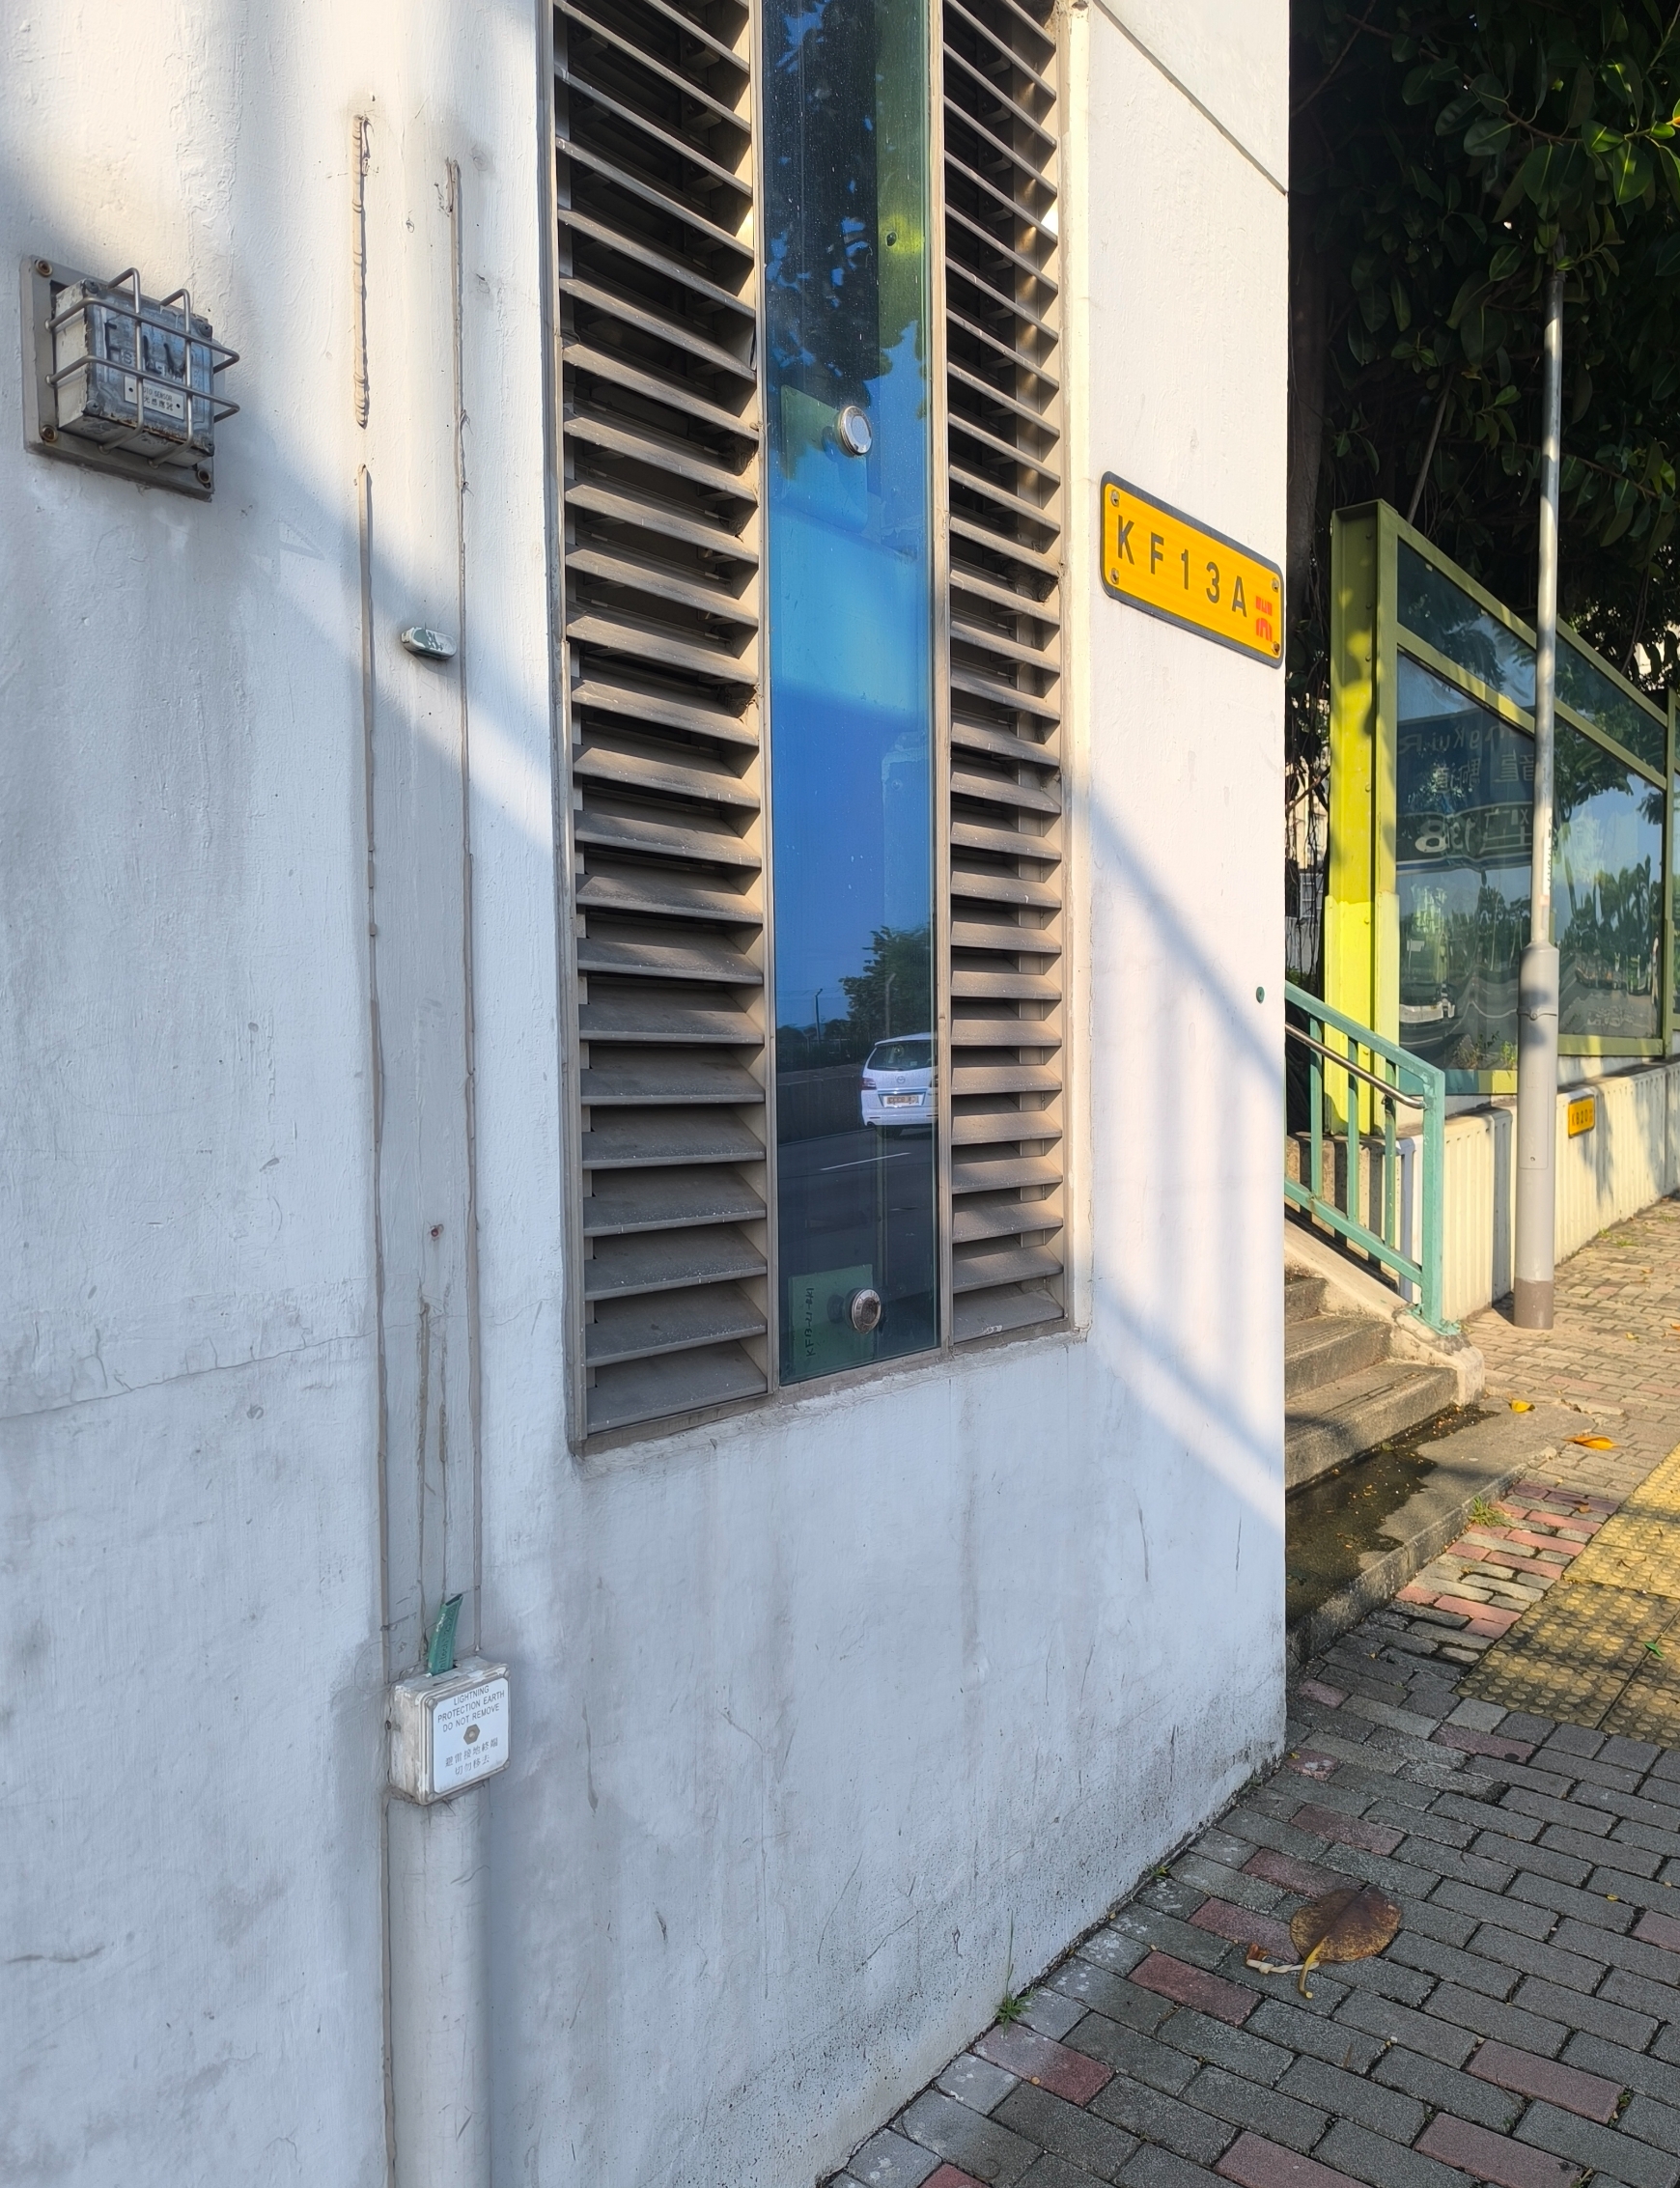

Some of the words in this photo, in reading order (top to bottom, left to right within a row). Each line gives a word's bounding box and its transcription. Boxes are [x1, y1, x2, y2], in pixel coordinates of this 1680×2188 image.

[154, 390, 173, 402] SENSOR
[1117, 514, 1247, 618] KF13A
[437, 1698, 481, 1724] PROTECTION
[483, 1689, 505, 1705] EARTH
[453, 1685, 490, 1706] LIGHTNING
[442, 1722, 454, 1733] DO
[456, 1715, 470, 1727] NOT
[472, 1703, 500, 1721] REMOVE
